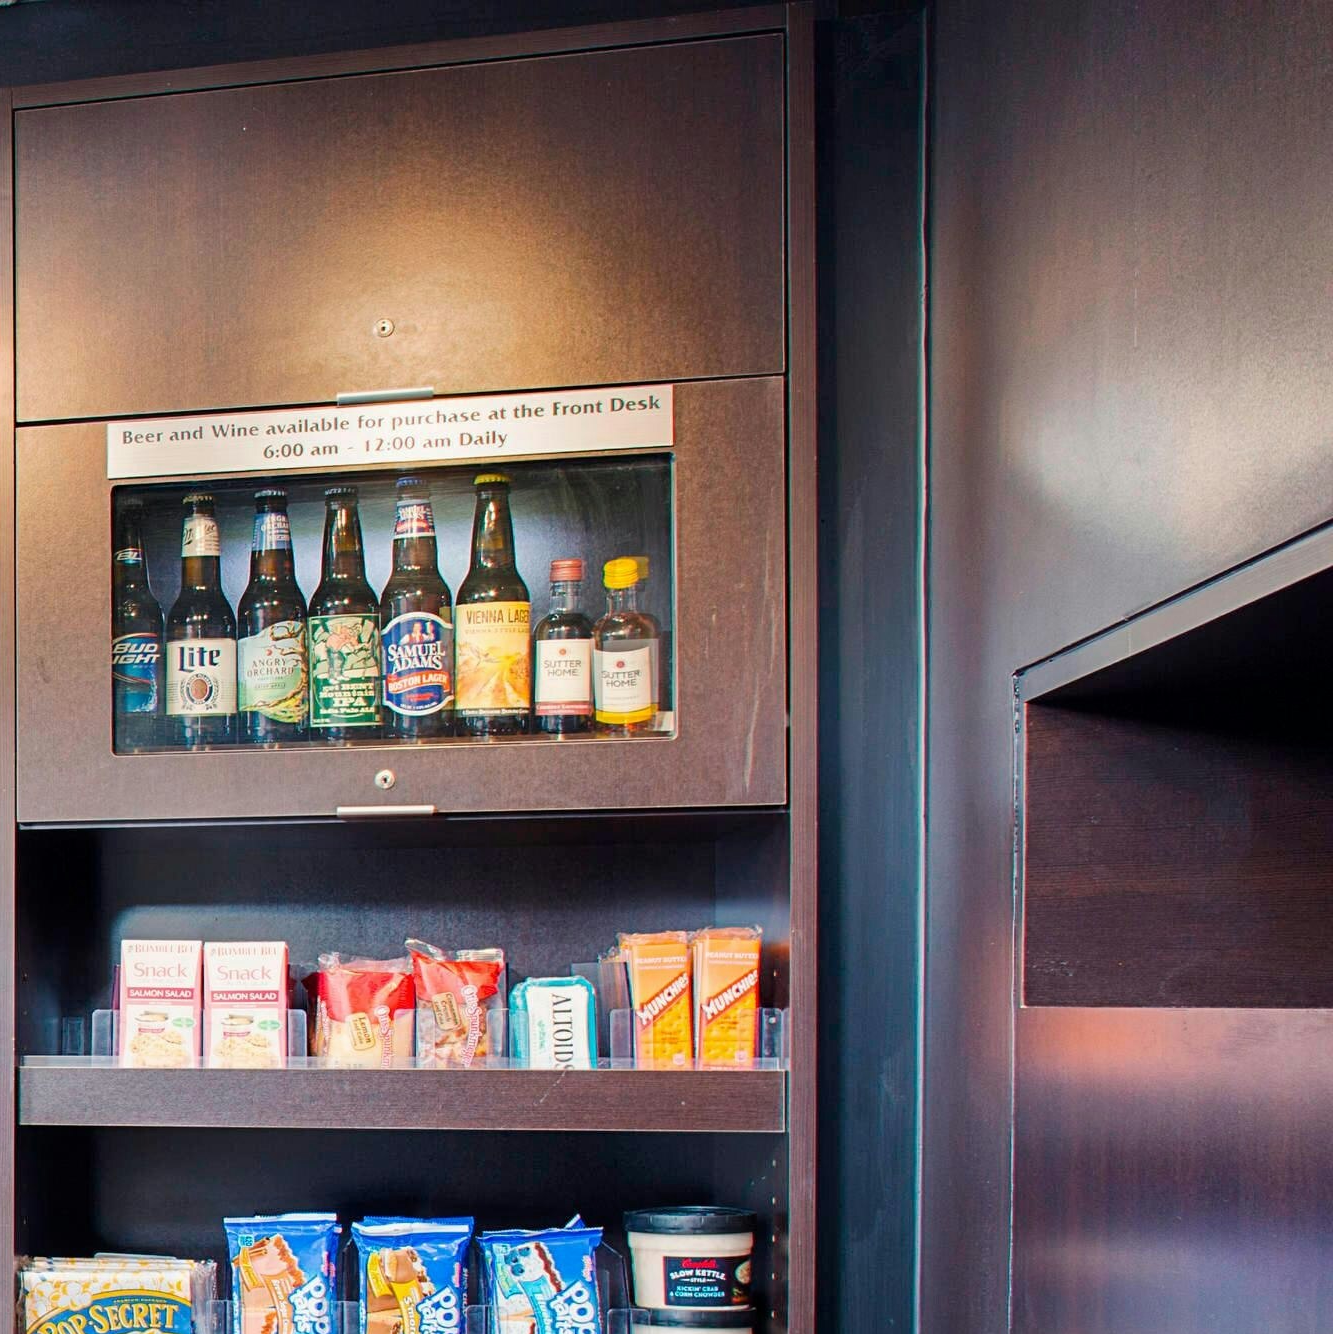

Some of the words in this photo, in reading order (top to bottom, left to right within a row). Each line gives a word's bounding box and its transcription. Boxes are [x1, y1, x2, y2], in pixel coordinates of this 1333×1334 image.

[122, 429, 164, 445] Beer
[169, 426, 204, 442] and
[212, 423, 260, 439] Wine
[265, 416, 350, 436] available
[357, 414, 384, 430] for
[391, 409, 481, 431] purchase
[488, 408, 507, 421] at
[513, 403, 545, 419] the
[552, 400, 603, 418] Front
[610, 395, 661, 413] Desk
[263, 443, 304, 460] 6:00
[310, 443, 339, 456] am
[364, 435, 416, 453] 12:00
[422, 436, 451, 449] am
[459, 430, 508, 448] Daily
[466, 609, 504, 624] VIENNA
[113, 642, 159, 654] BUD
[387, 641, 446, 661] SAMUEL
[178, 646, 221, 673] Lite
[252, 658, 288, 669] ANGRY
[392, 656, 443, 675] ADAMS
[543, 660, 582, 669] SUTTER
[246, 666, 295, 677] ORCHARD
[547, 668, 579, 677] HOME
[601, 669, 641, 680] SUTTER
[606, 679, 638, 688] HOME
[134, 961, 188, 979] Snack
[217, 965, 273, 981] Snack
[130, 989, 165, 998] SALMON
[165, 990, 193, 999] SALAD
[213, 993, 249, 1001] SALMON
[249, 993, 277, 1001] SALAD
[358, 1016, 373, 1045] Lemon
[669, 1270, 694, 1280] SLOW
[695, 1268, 727, 1281] KETTLE
